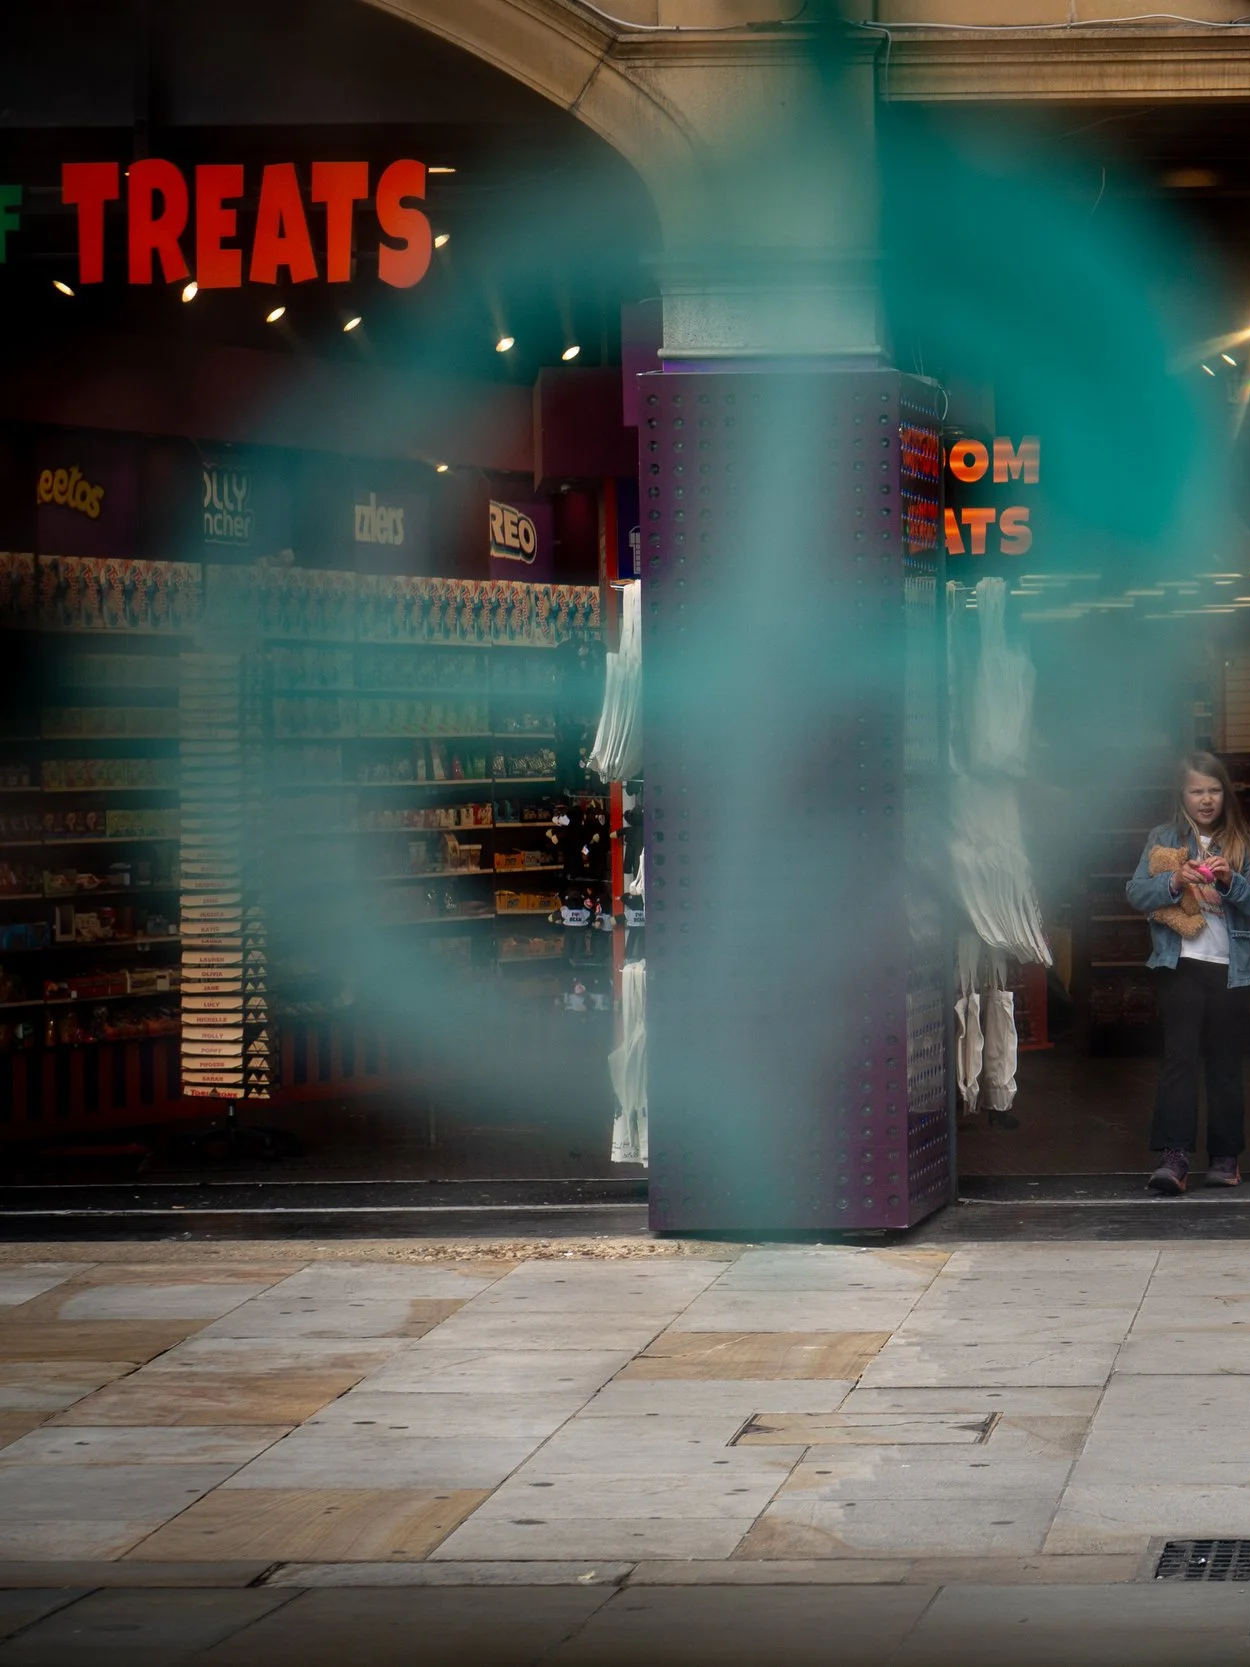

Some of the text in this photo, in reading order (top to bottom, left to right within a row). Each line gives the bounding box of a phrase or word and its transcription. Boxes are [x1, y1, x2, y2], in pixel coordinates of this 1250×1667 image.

[62, 158, 432, 288] TREATS
[943, 435, 1041, 485] OM
[37, 463, 105, 520] eetos
[204, 509, 251, 539] ncher
[489, 503, 536, 555] REO
